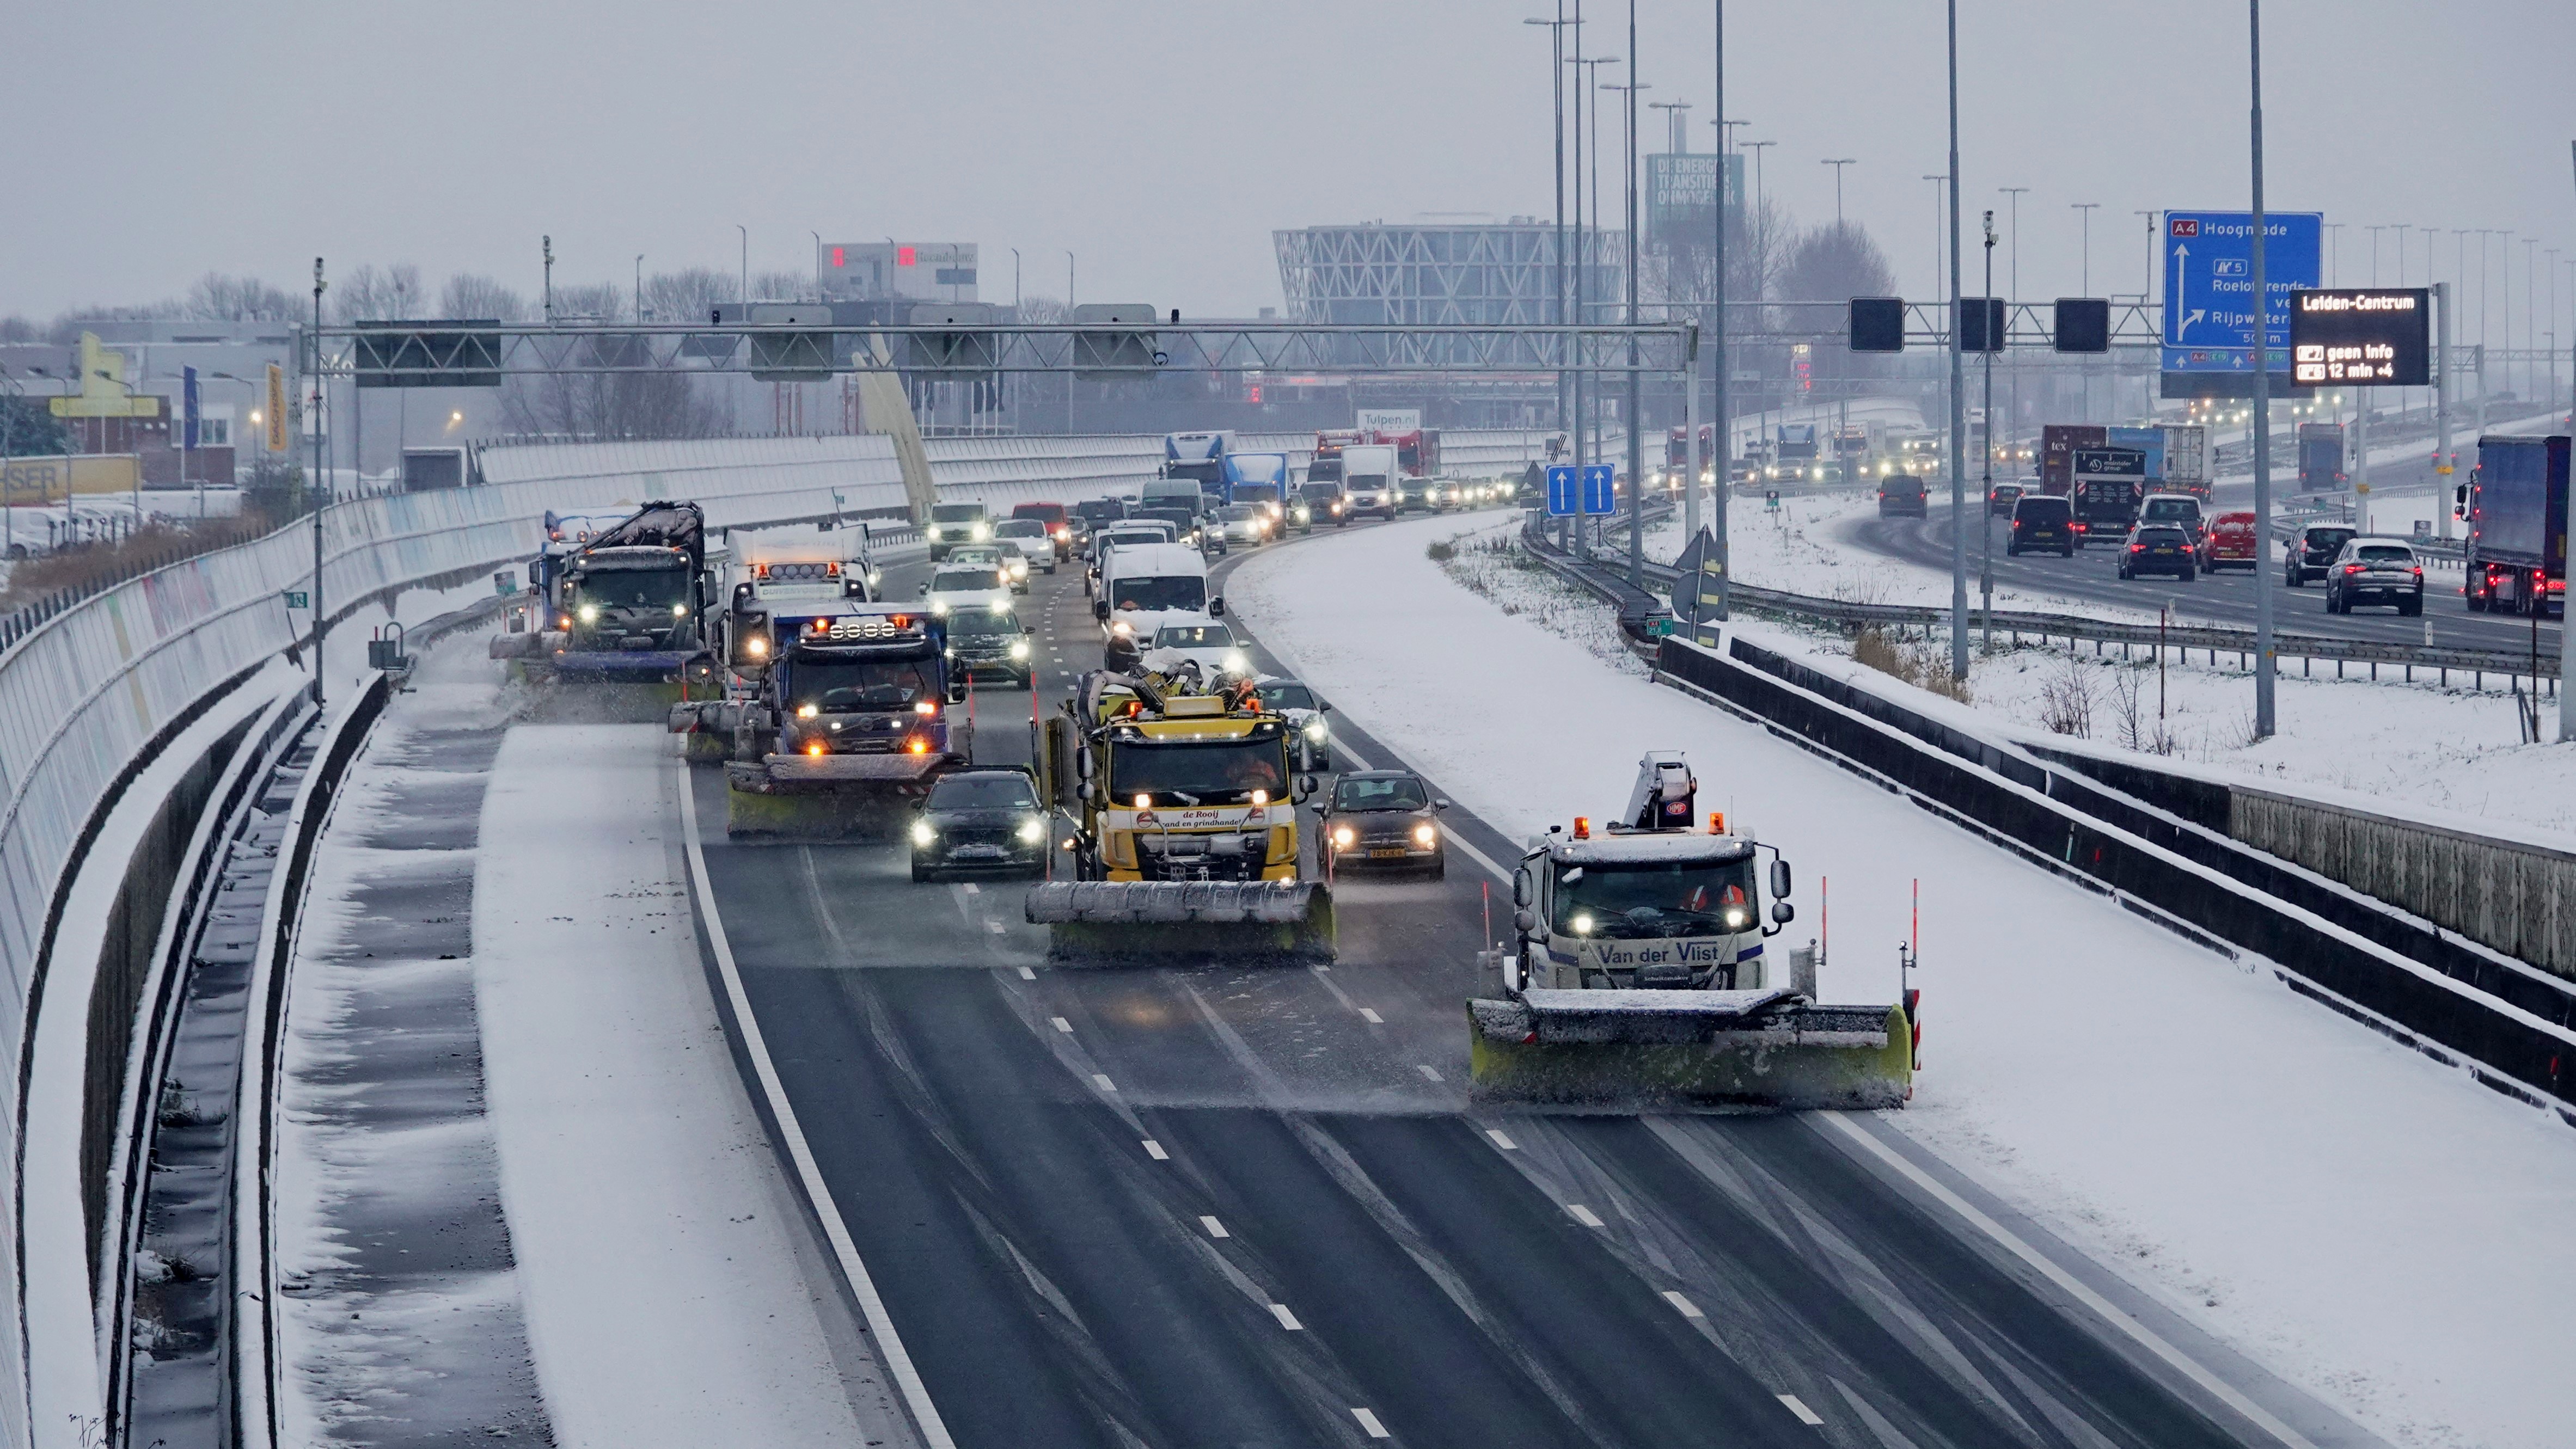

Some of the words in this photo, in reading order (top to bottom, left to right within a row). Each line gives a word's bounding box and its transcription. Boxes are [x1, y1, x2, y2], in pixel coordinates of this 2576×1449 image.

[1675, 158, 1728, 173] ENERGI-
[2175, 224, 2196, 234] A4
[2235, 263, 2242, 272] 5
[2303, 294, 2415, 311] Leiden-Centrum
[2270, 335, 2281, 343] m
[2327, 347, 2361, 361] geen
[2365, 344, 2394, 359] info
[2314, 367, 2322, 377] 6
[2328, 363, 2344, 378] 12
[2347, 363, 2373, 378] min
[2377, 363, 2394, 377] +4
[1365, 414, 1415, 429] Tulpen.nl
[1183, 811, 1194, 819] de
[1196, 810, 1219, 819] Rooij
[1669, 803, 1684, 813] HMF
[1598, 944, 1633, 963] Van
[1639, 948, 1669, 962] der
[1675, 941, 1719, 961] Vlist
